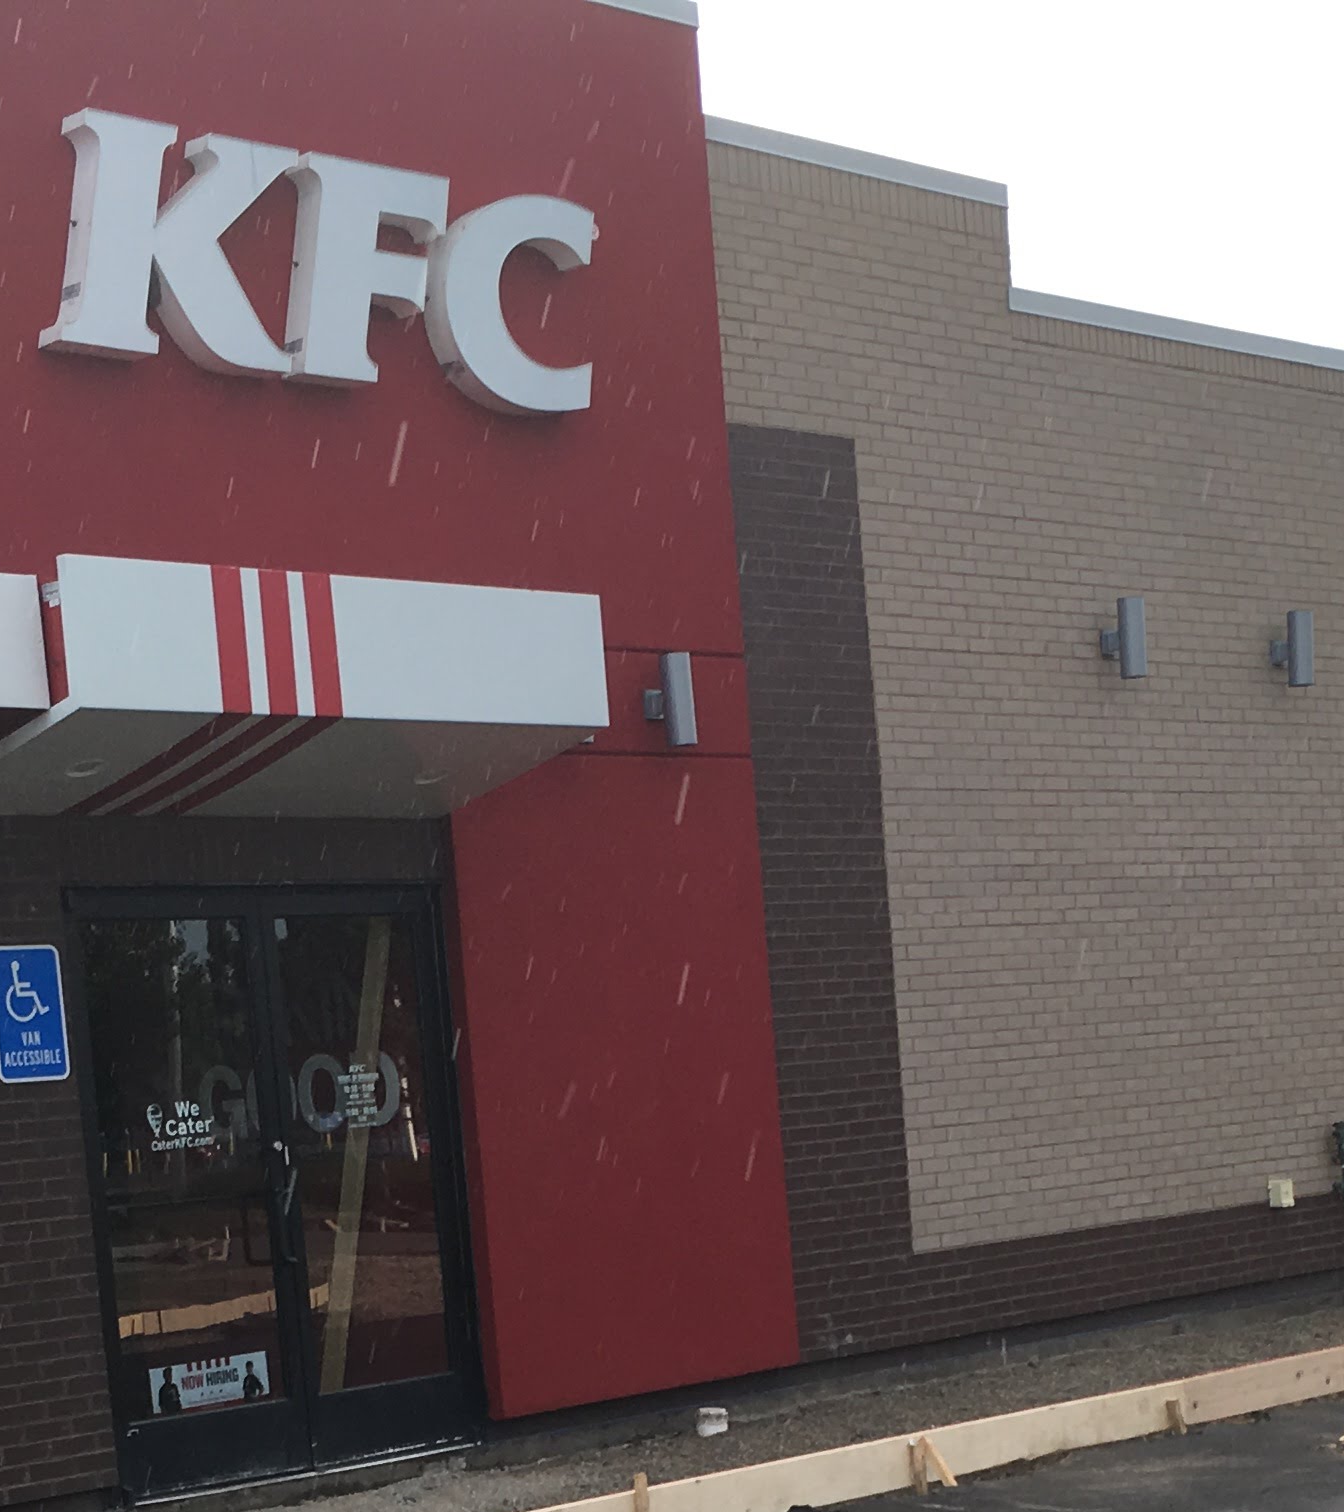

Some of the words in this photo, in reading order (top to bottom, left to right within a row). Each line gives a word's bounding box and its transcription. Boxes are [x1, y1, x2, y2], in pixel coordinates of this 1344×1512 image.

[38, 107, 597, 417] KFC
[21, 1031, 41, 1046] VAN
[4, 1048, 62, 1068] ACCESSIBLE
[174, 1100, 200, 1118] We
[165, 1117, 213, 1137] Cater
[181, 1373, 204, 1391] NOW
[205, 1367, 240, 1387] HIRING
